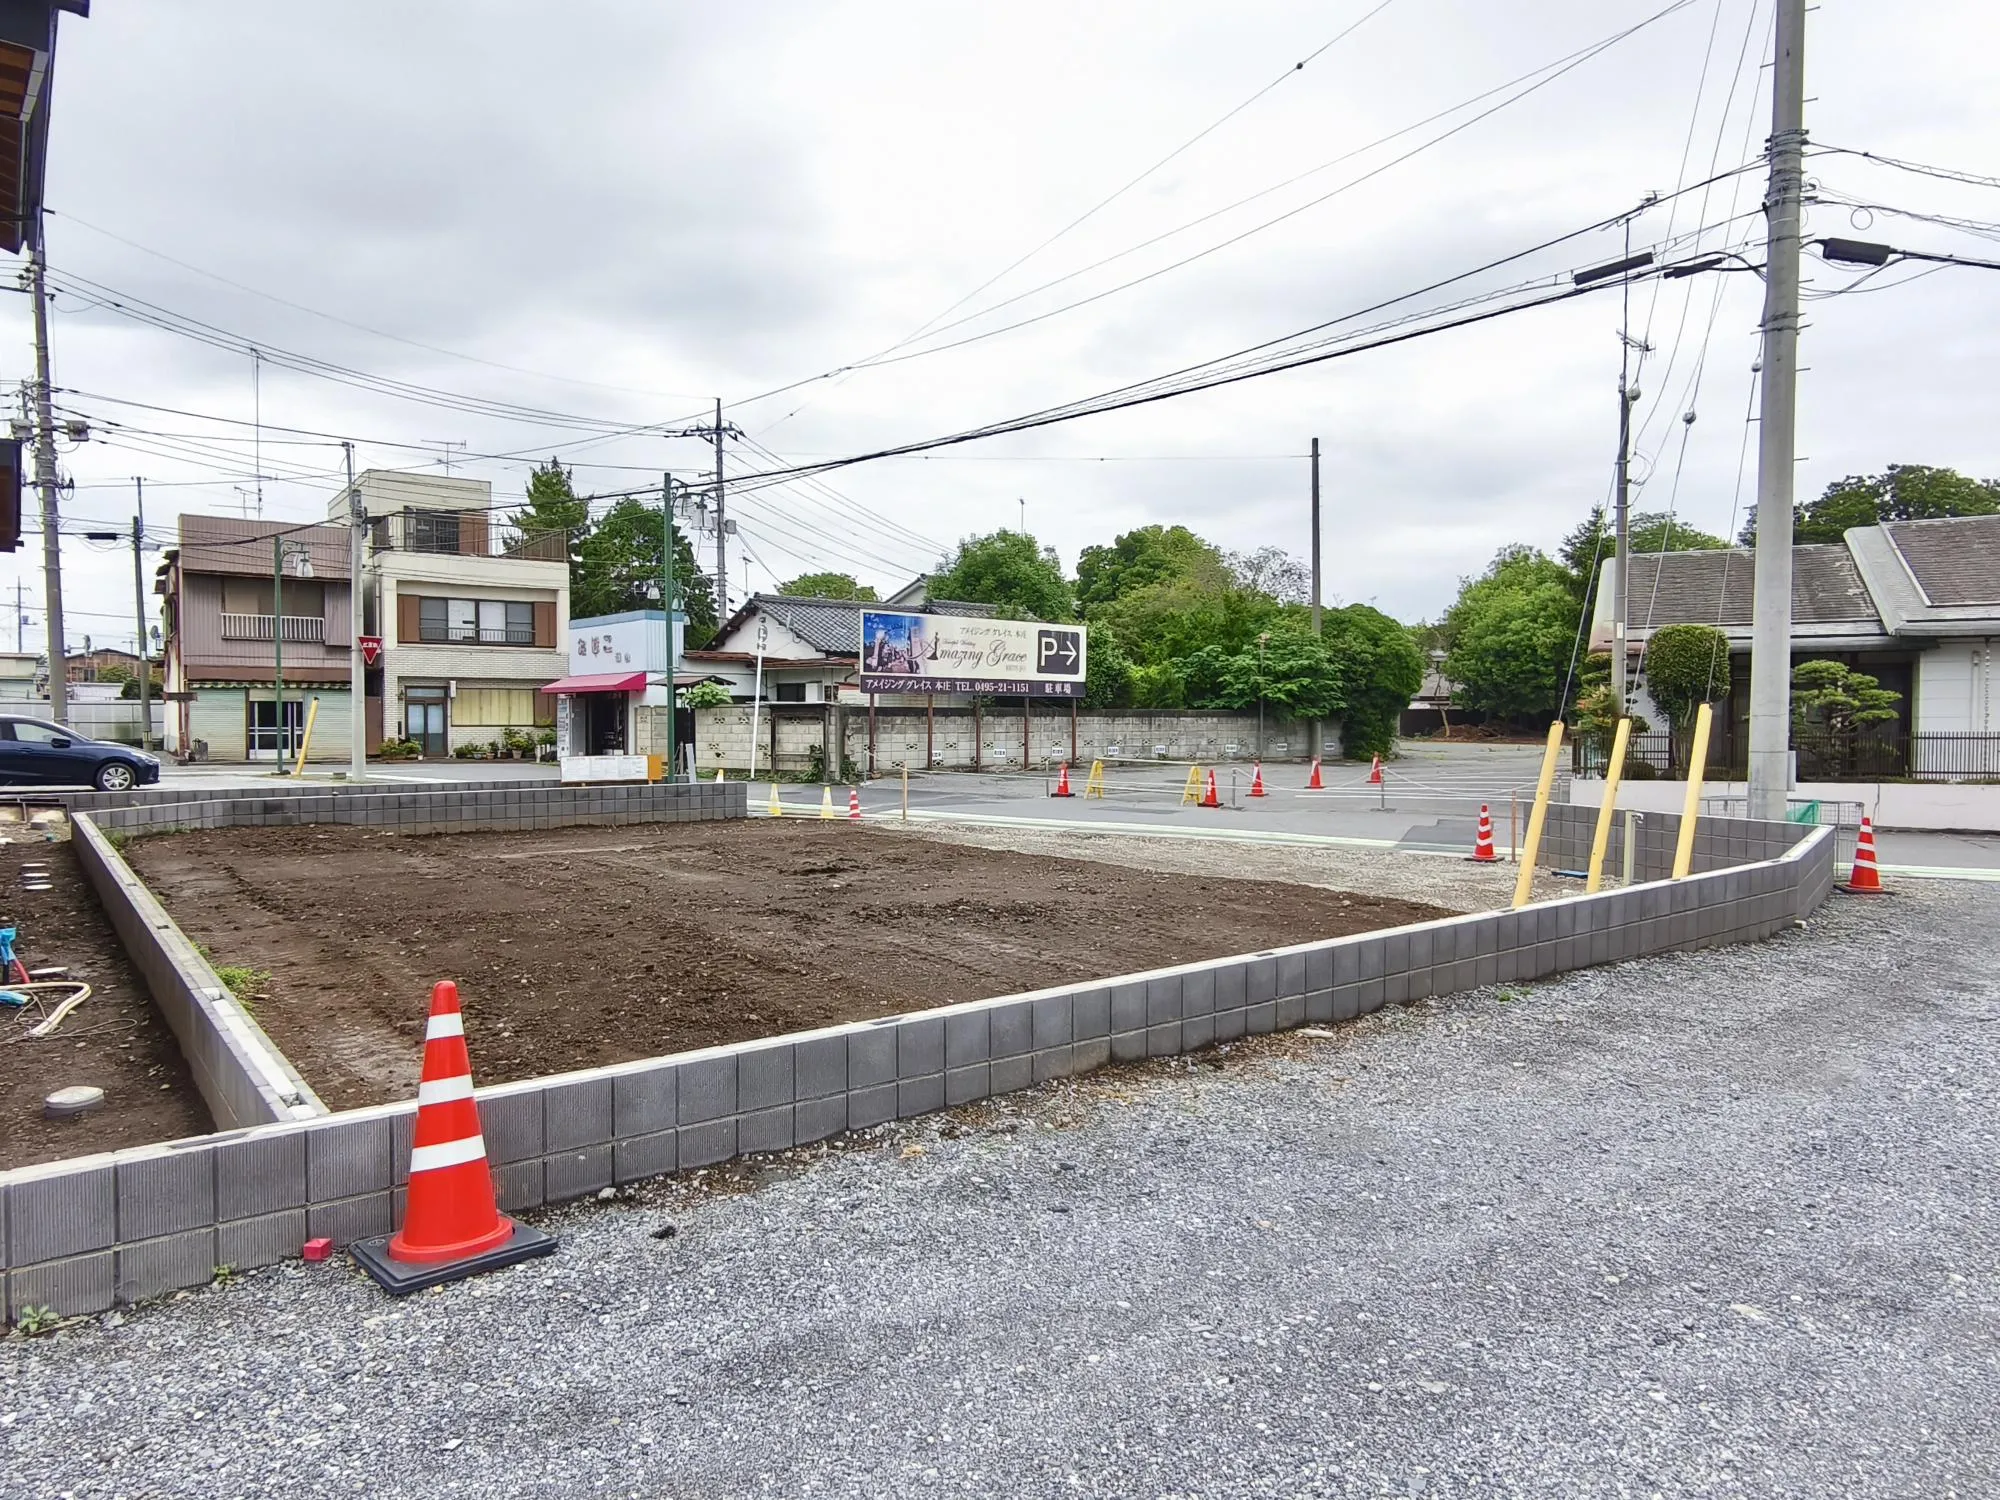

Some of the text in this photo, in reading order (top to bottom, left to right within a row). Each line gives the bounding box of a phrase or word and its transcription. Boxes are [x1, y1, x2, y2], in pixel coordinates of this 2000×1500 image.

[986, 639, 1028, 667] Grace
[1040, 636, 1058, 667] P
[865, 678, 905, 690] アメイジング
[906, 679, 932, 690] グレイス
[935, 680, 952, 691] 本庄
[1044, 683, 1072, 694] 駐車場
